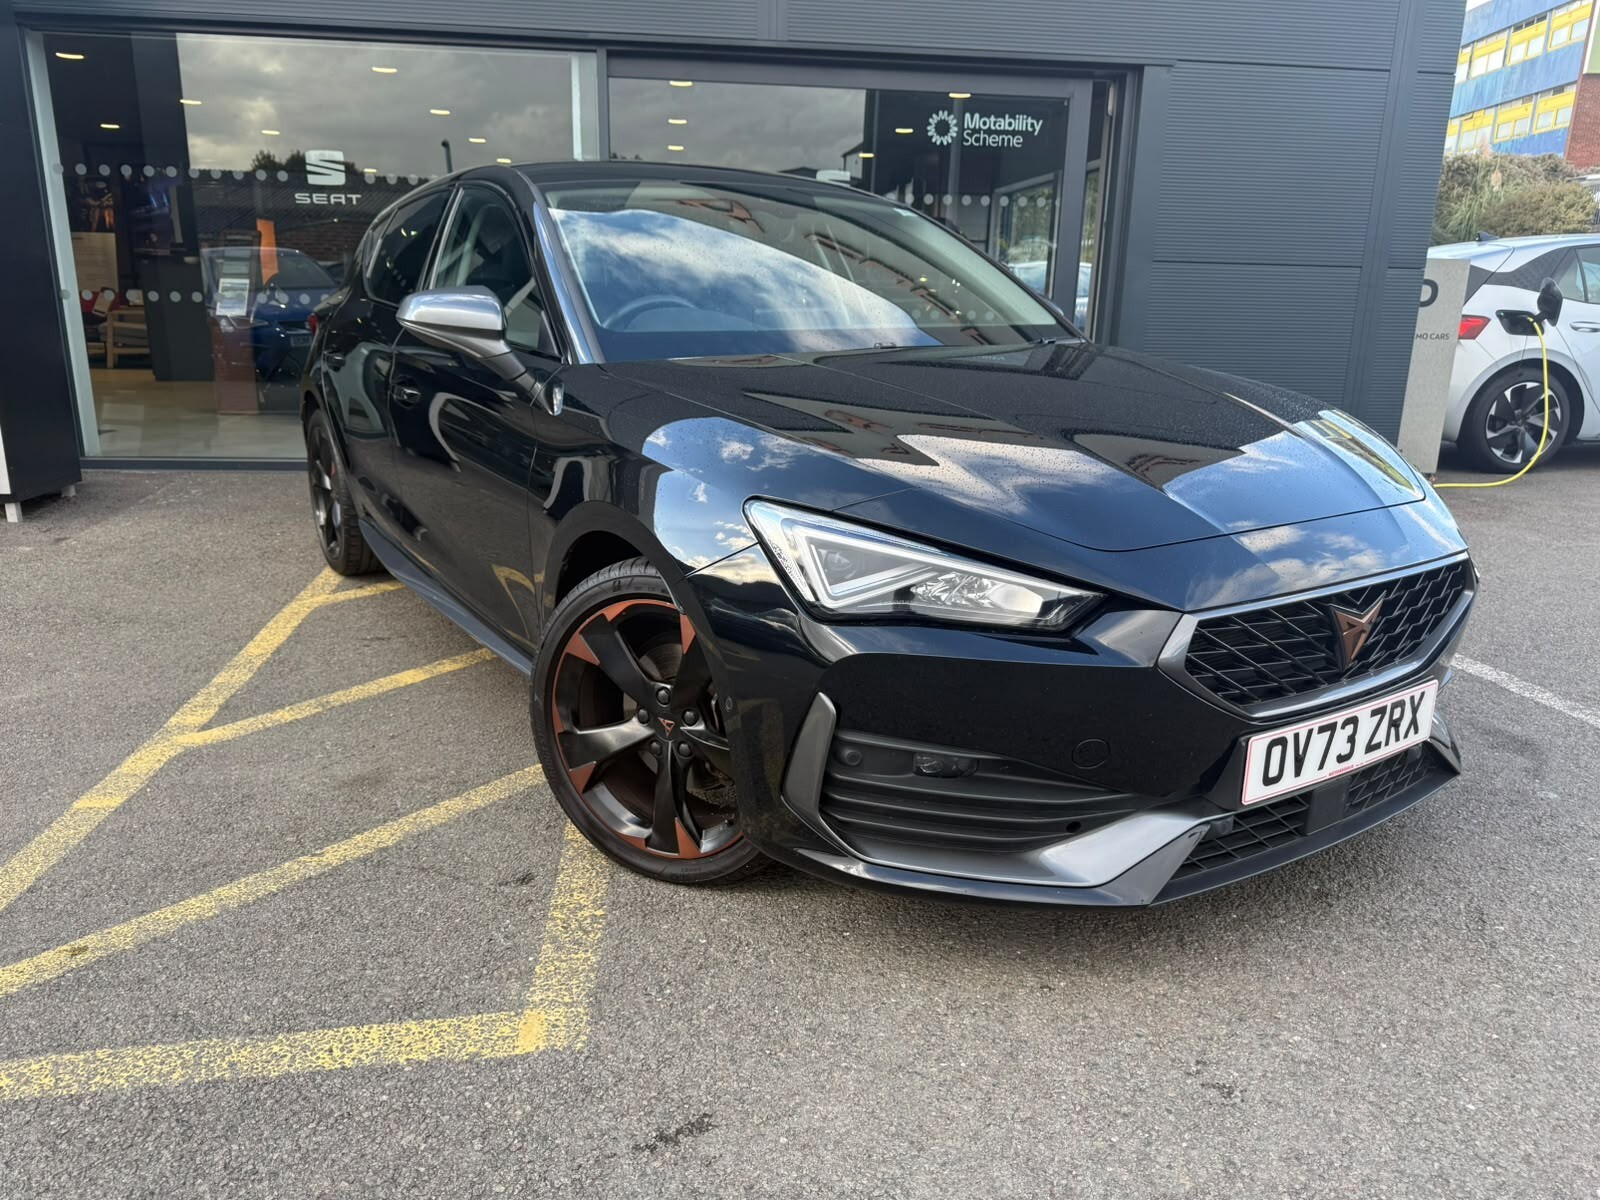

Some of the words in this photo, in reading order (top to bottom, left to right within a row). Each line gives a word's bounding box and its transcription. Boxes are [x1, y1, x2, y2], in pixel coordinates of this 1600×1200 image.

[964, 112, 1043, 136] Motability
[962, 130, 1024, 148] Scheme
[294, 193, 362, 205] SEAT
[1429, 332, 1450, 341] CARS
[1262, 715, 1359, 787] OV73
[1364, 691, 1426, 755] ZRX
